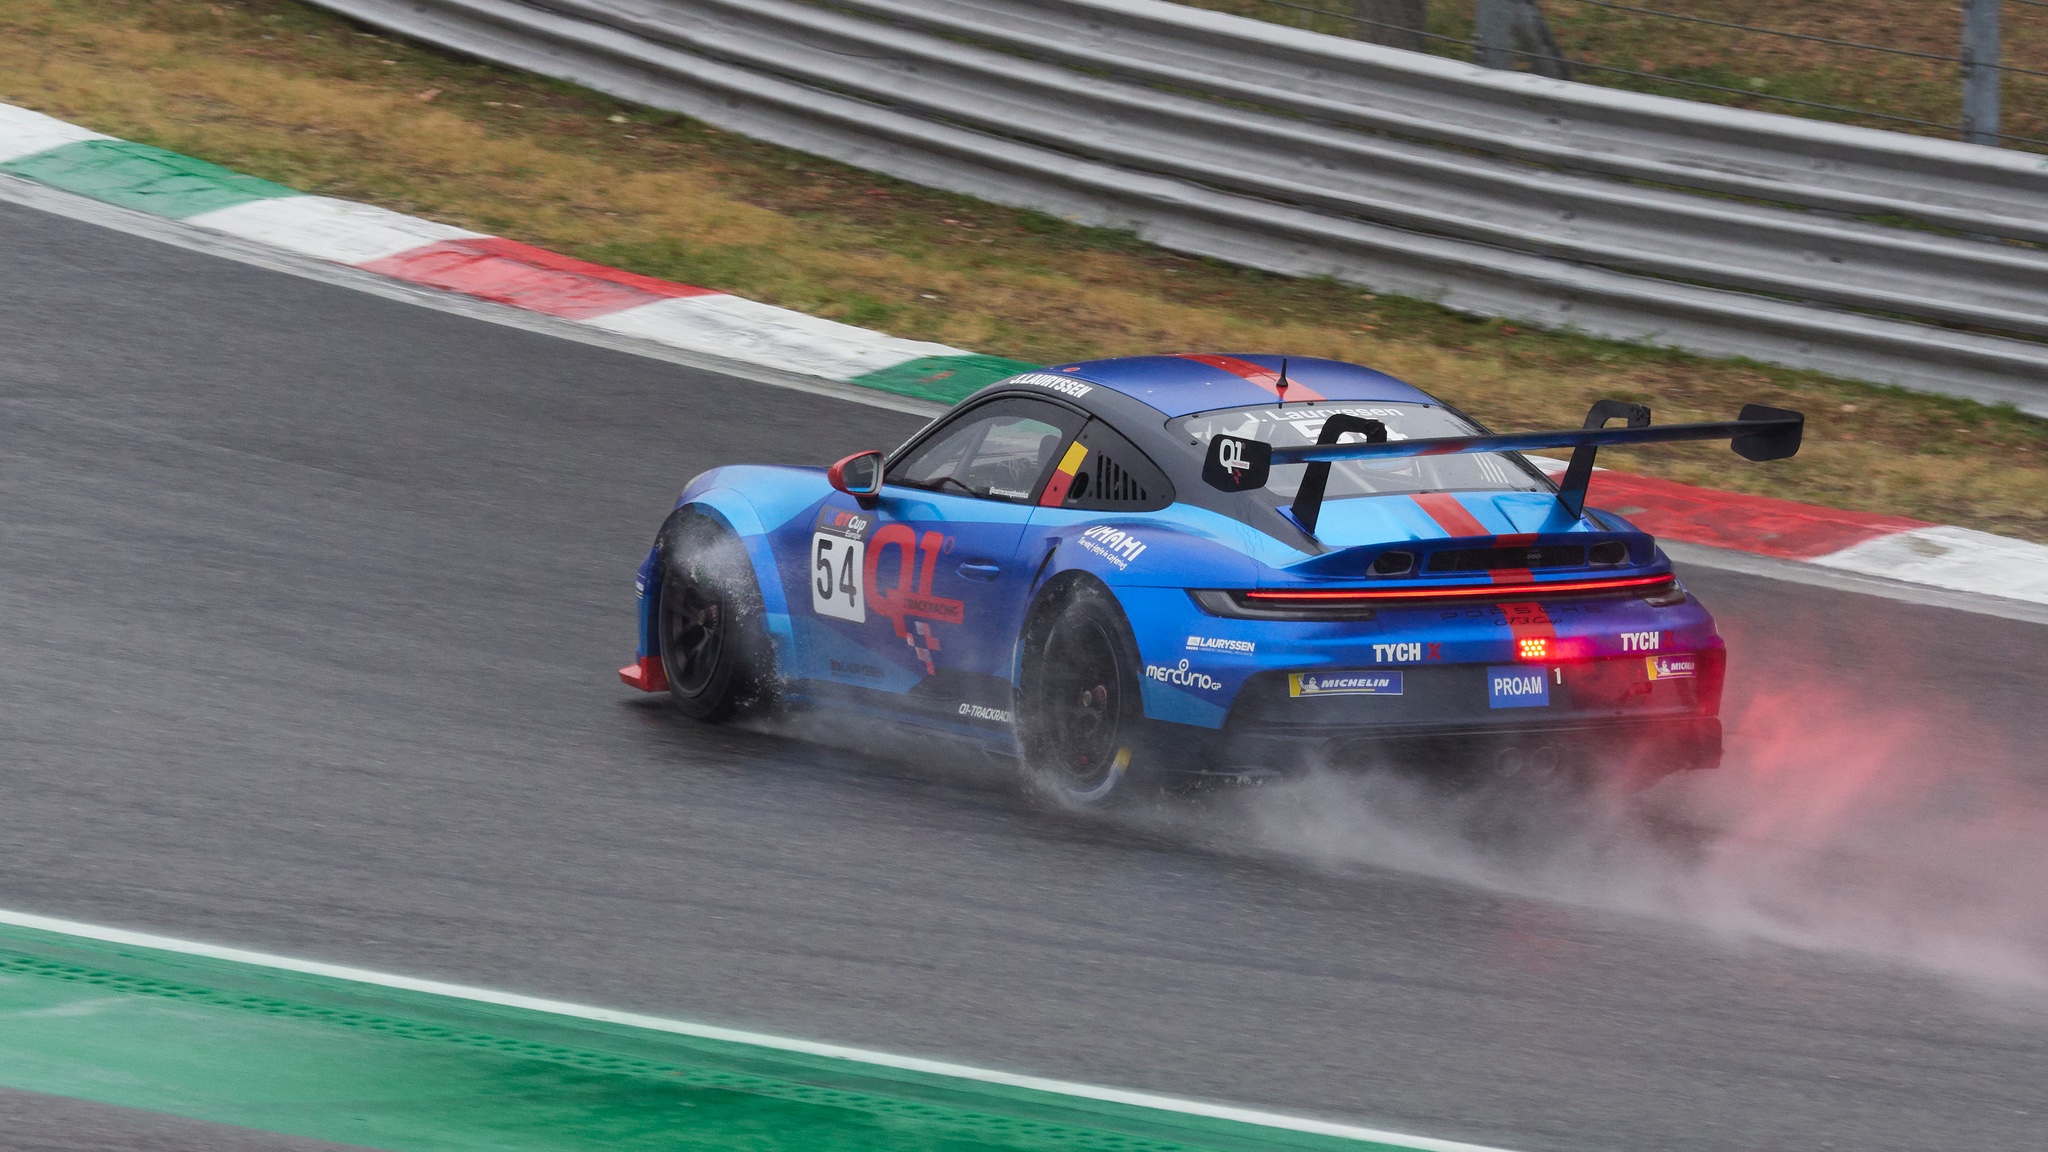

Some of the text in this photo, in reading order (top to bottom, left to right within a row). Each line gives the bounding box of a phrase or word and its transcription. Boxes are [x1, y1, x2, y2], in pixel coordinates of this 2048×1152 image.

[1010, 374, 1093, 398] J.LAURYSSEN
[1244, 407, 1405, 424] J. Lauryssen
[1084, 525, 1147, 562] UMAMI
[816, 538, 857, 608] 54
[1440, 605, 1603, 620] PORSCHE
[1533, 616, 1563, 626] Cup
[1200, 637, 1255, 653] LAURYSSEN
[1621, 631, 1659, 651] TYCH
[1373, 642, 1441, 662] TYCH X
[1321, 678, 1390, 688] MICHELIN
[1554, 667, 1562, 685] 1
[1494, 676, 1542, 696] PROAM
